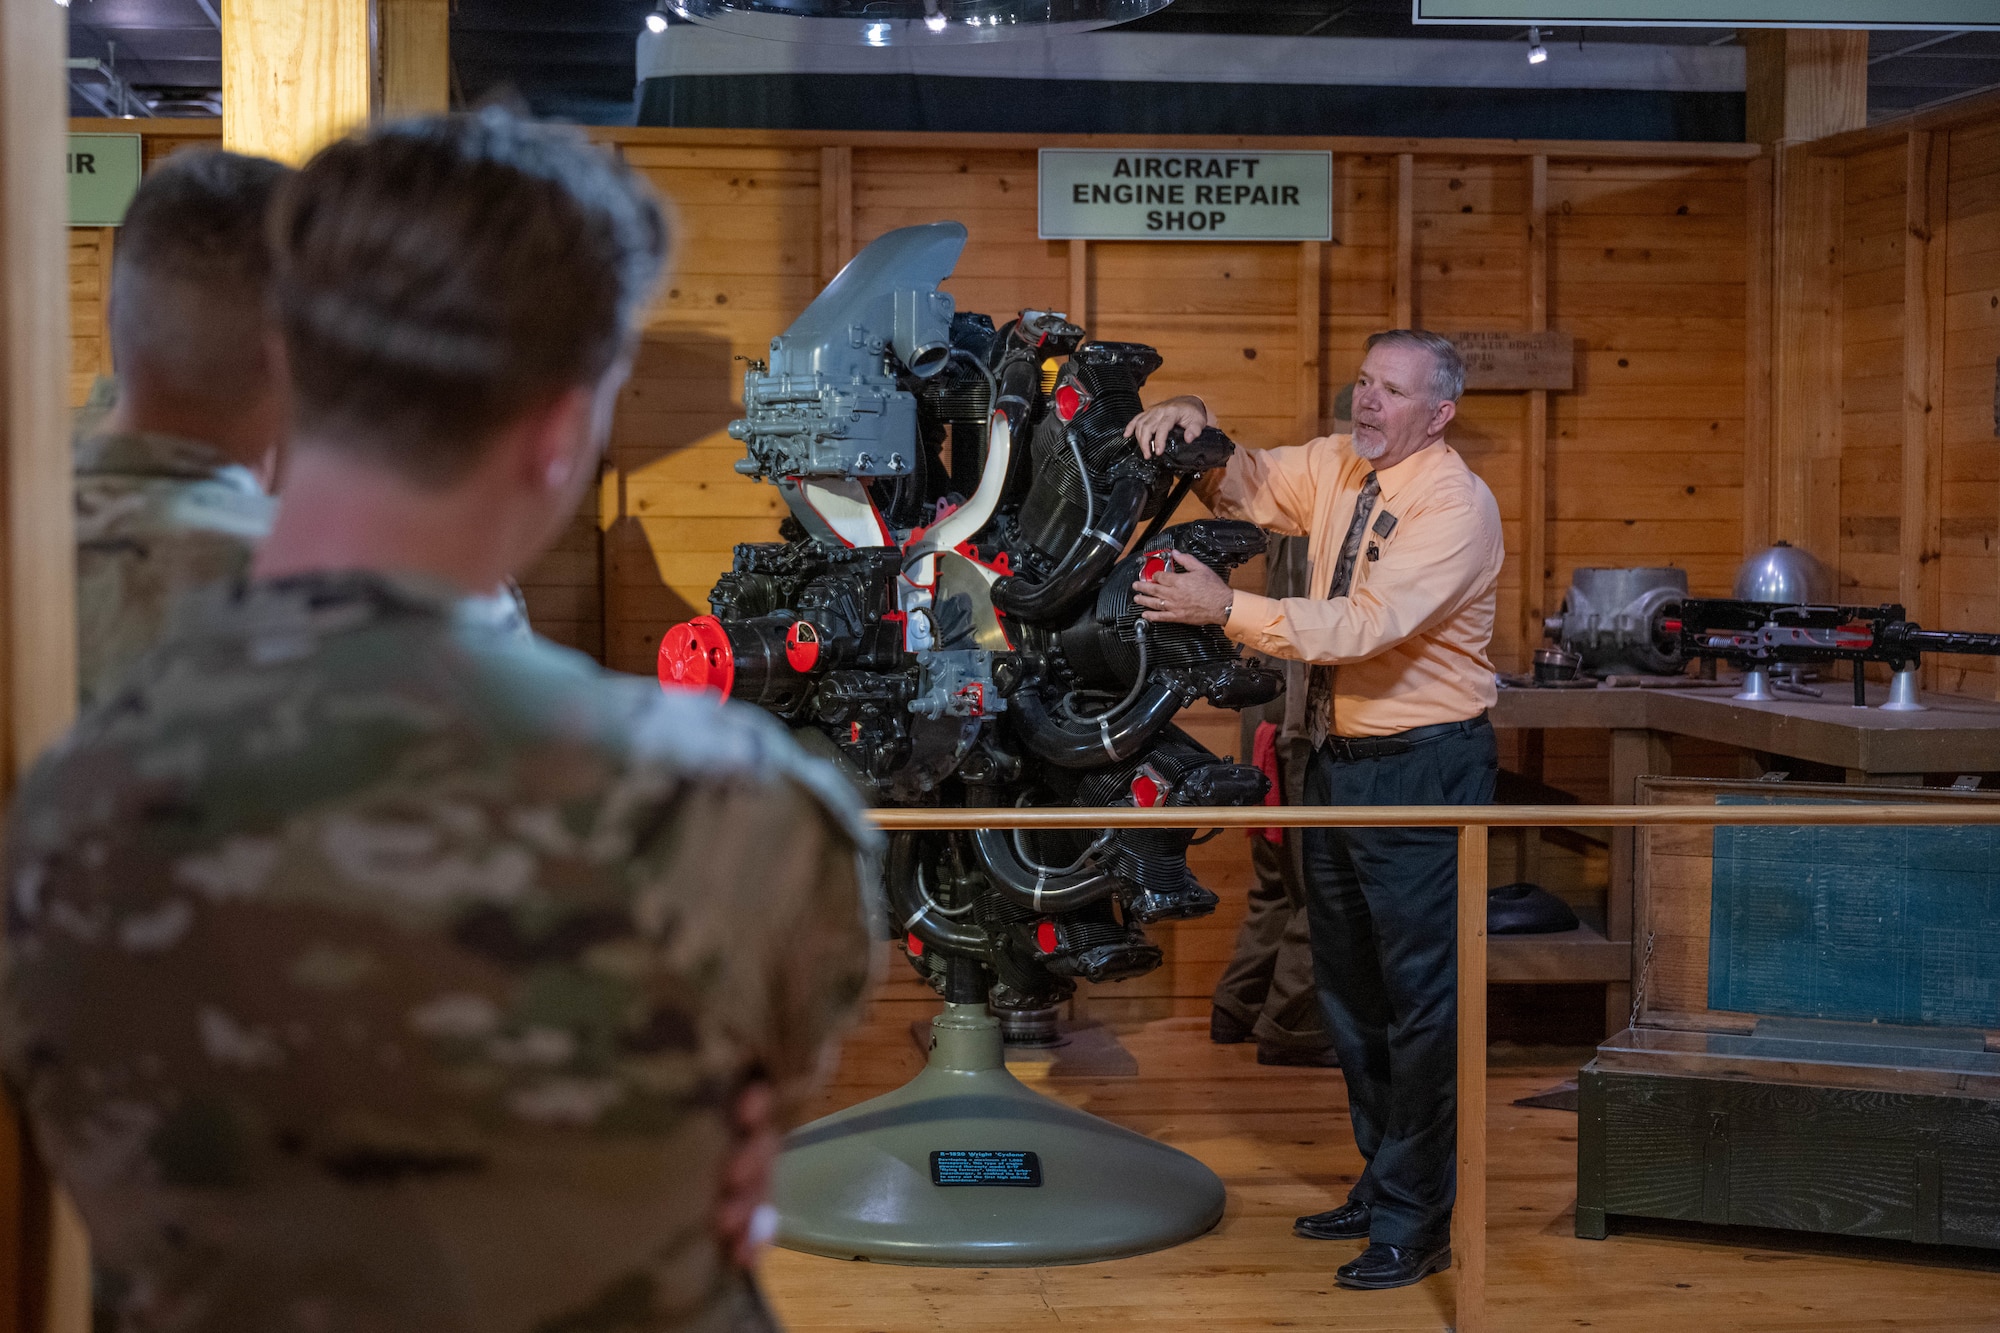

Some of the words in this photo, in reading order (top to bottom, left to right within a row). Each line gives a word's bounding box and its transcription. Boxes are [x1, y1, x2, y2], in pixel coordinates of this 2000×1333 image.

[1113, 158, 1260, 179] AIRCRAFT
[1072, 184, 1185, 205] ENGINE
[1195, 185, 1300, 206] REPAIR
[1146, 211, 1226, 231] SHOP
